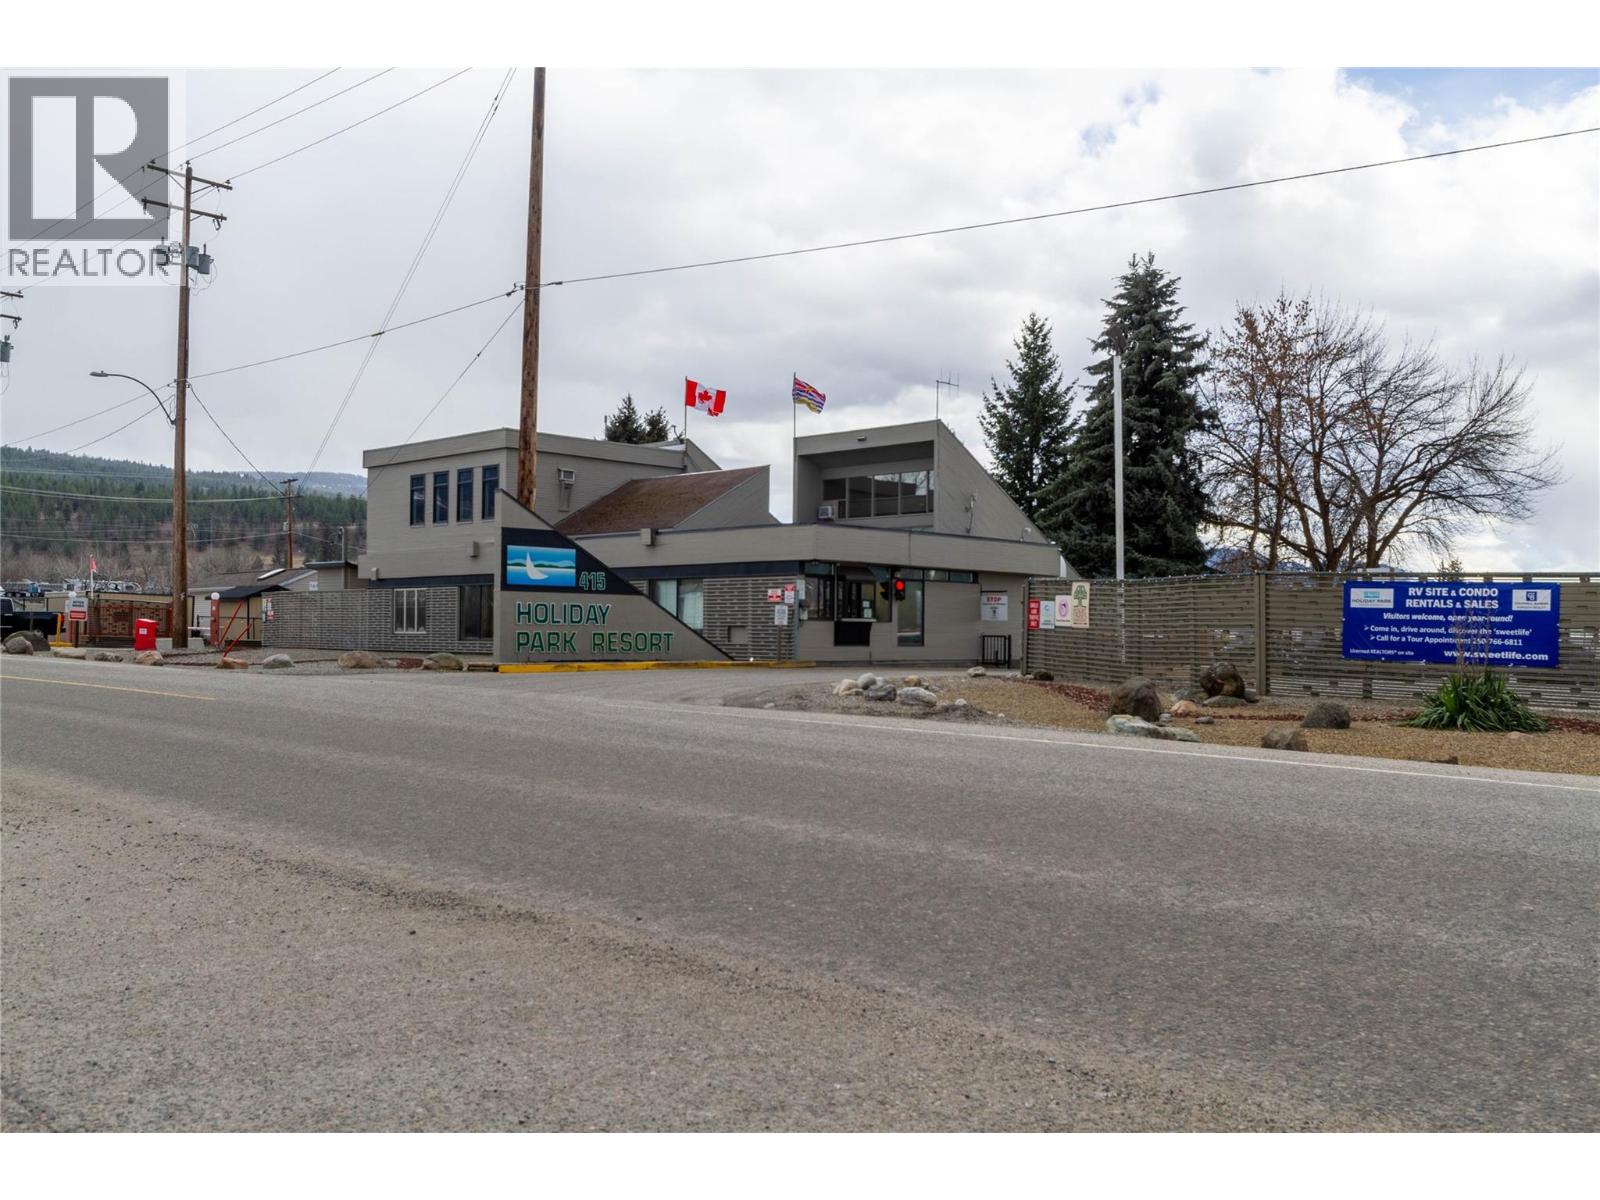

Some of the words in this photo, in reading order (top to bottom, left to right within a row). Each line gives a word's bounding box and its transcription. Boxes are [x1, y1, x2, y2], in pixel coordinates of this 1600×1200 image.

[578, 571, 606, 591] 415
[1408, 587, 1423, 596] RV
[1425, 587, 1449, 596] SITE
[1458, 587, 1499, 597] CONDO
[1405, 599, 1453, 608] RENTALS
[1463, 600, 1499, 609] SALES
[515, 601, 611, 625] HOLIDAY
[1383, 612, 1410, 620] Visitors
[1411, 613, 1446, 622] welcome,
[1390, 625, 1400, 633] in,
[1400, 625, 1418, 633] drive
[1419, 626, 1447, 635] around,
[515, 631, 577, 653] PARK
[591, 632, 674, 653] RESORT
[1390, 634, 1401, 642] for
